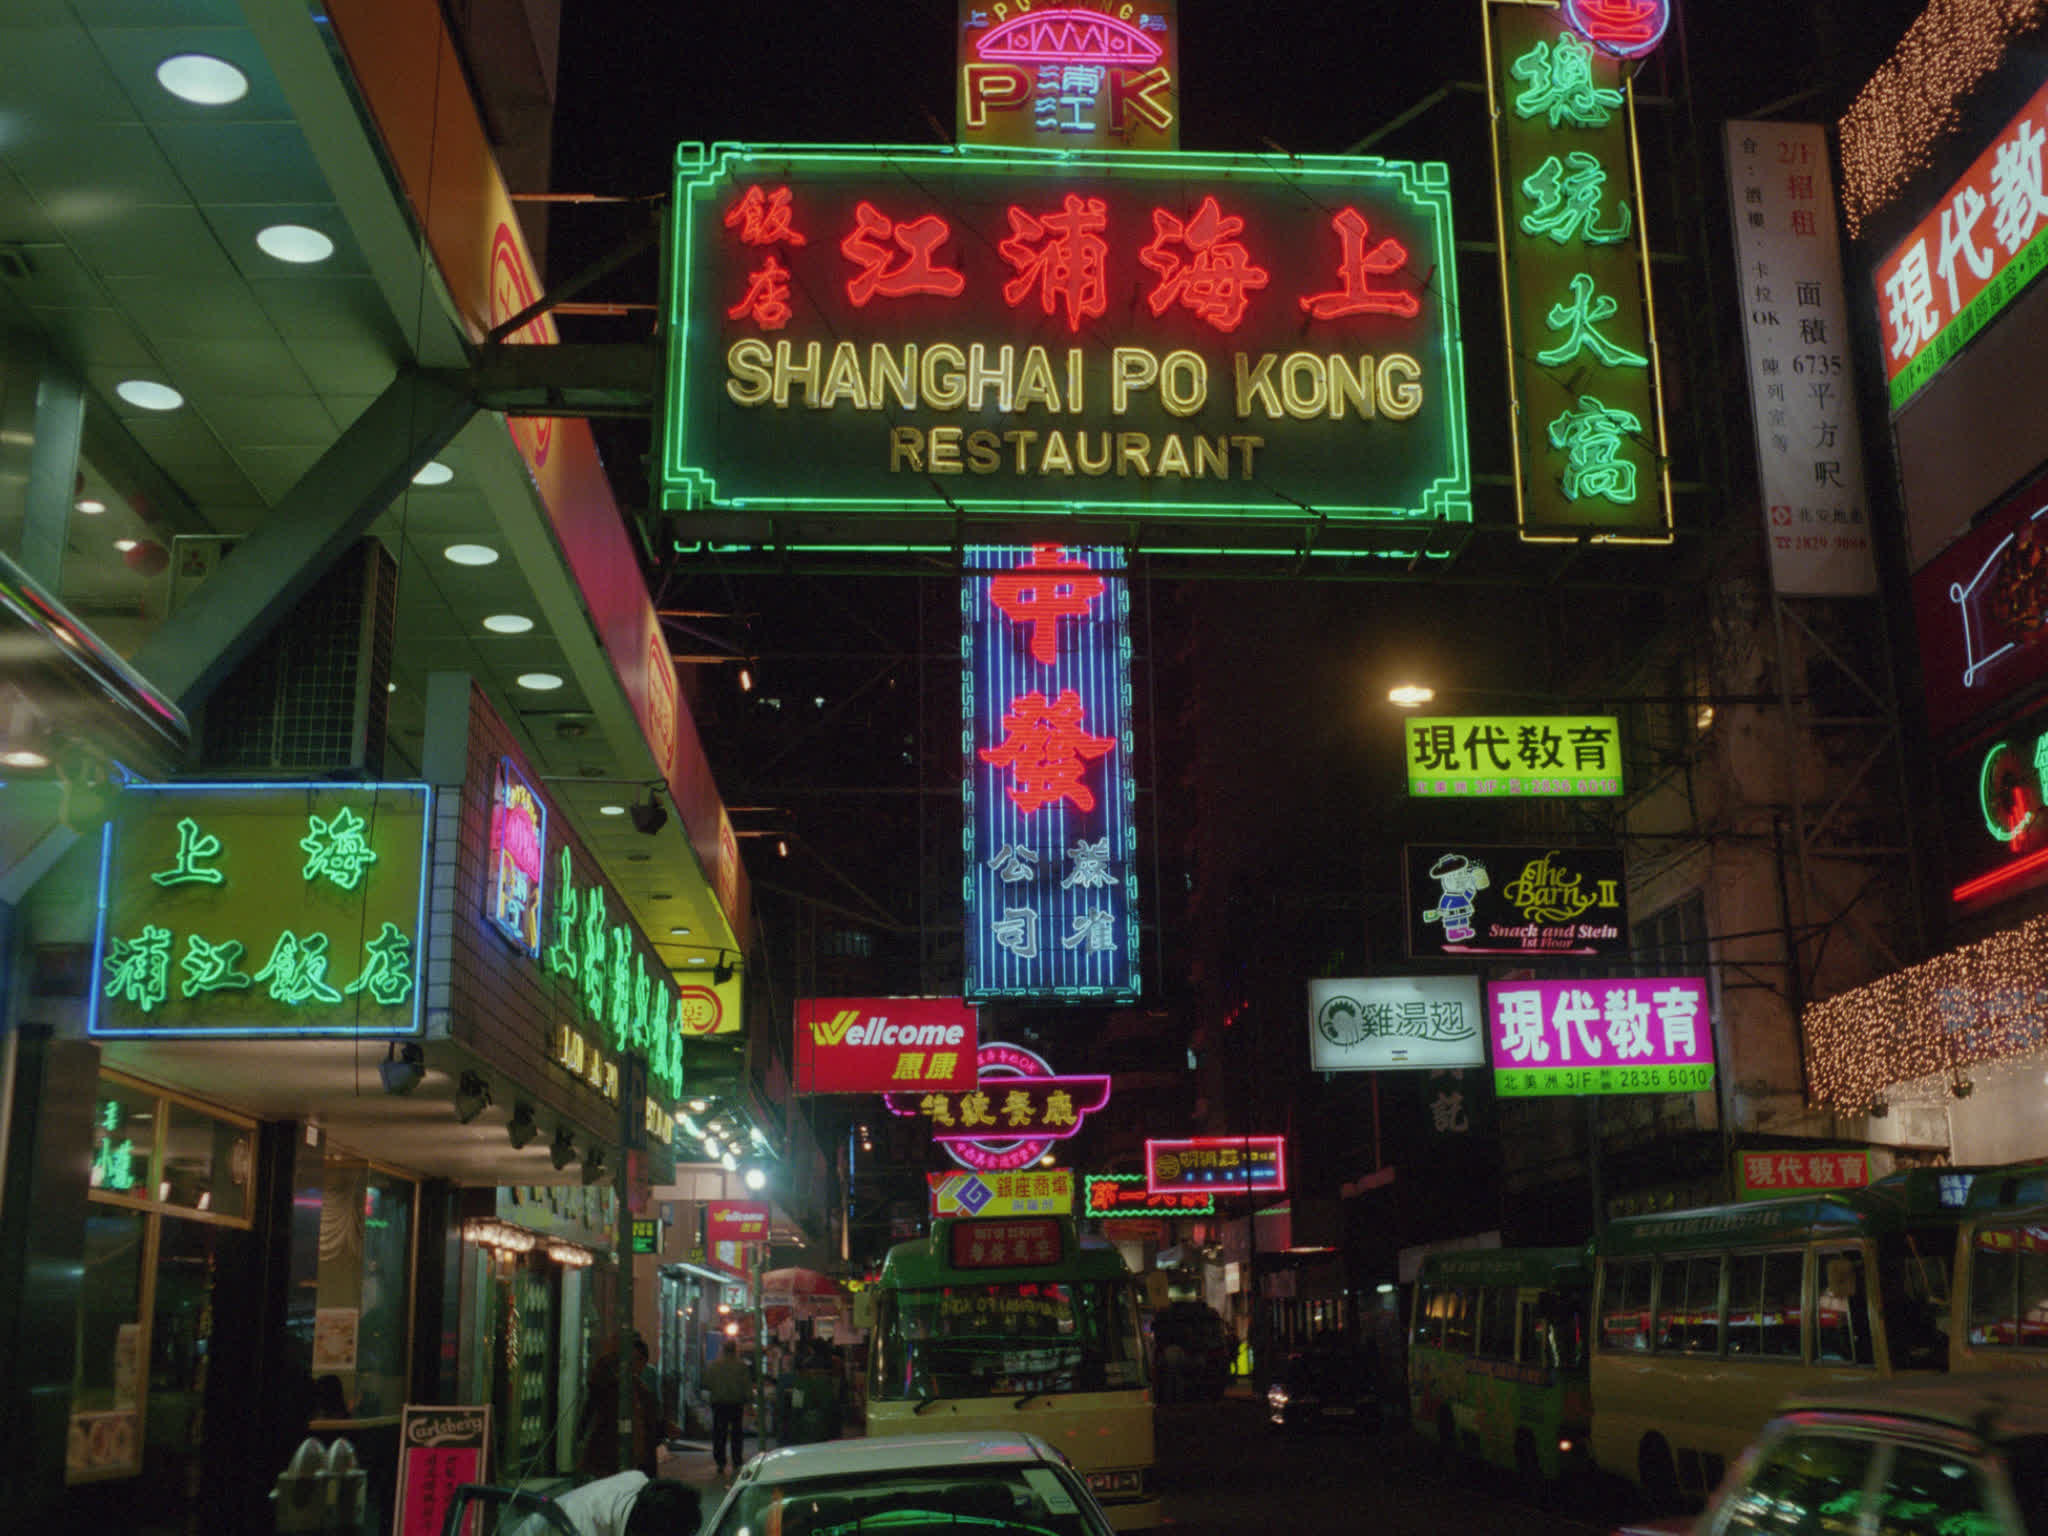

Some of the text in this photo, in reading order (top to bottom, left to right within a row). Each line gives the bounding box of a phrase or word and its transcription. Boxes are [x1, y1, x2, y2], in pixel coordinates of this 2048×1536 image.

[725, 184, 805, 329] 飯店
[1886, 119, 2048, 360] 現代教
[727, 338, 1423, 421] SHANGHAI PO KONG
[891, 426, 1266, 481] RESTAURANT
[1521, 850, 1583, 887] The
[1504, 879, 1598, 912] Barn
[1489, 923, 1619, 939] Snack and Stein
[103, 921, 413, 1013] 浦江飯店
[809, 1010, 965, 1046] Wellcome
[891, 1052, 959, 1080] 惠康
[1620, 1070, 1660, 1088] 2836
[1668, 1068, 1708, 1086] 6010
